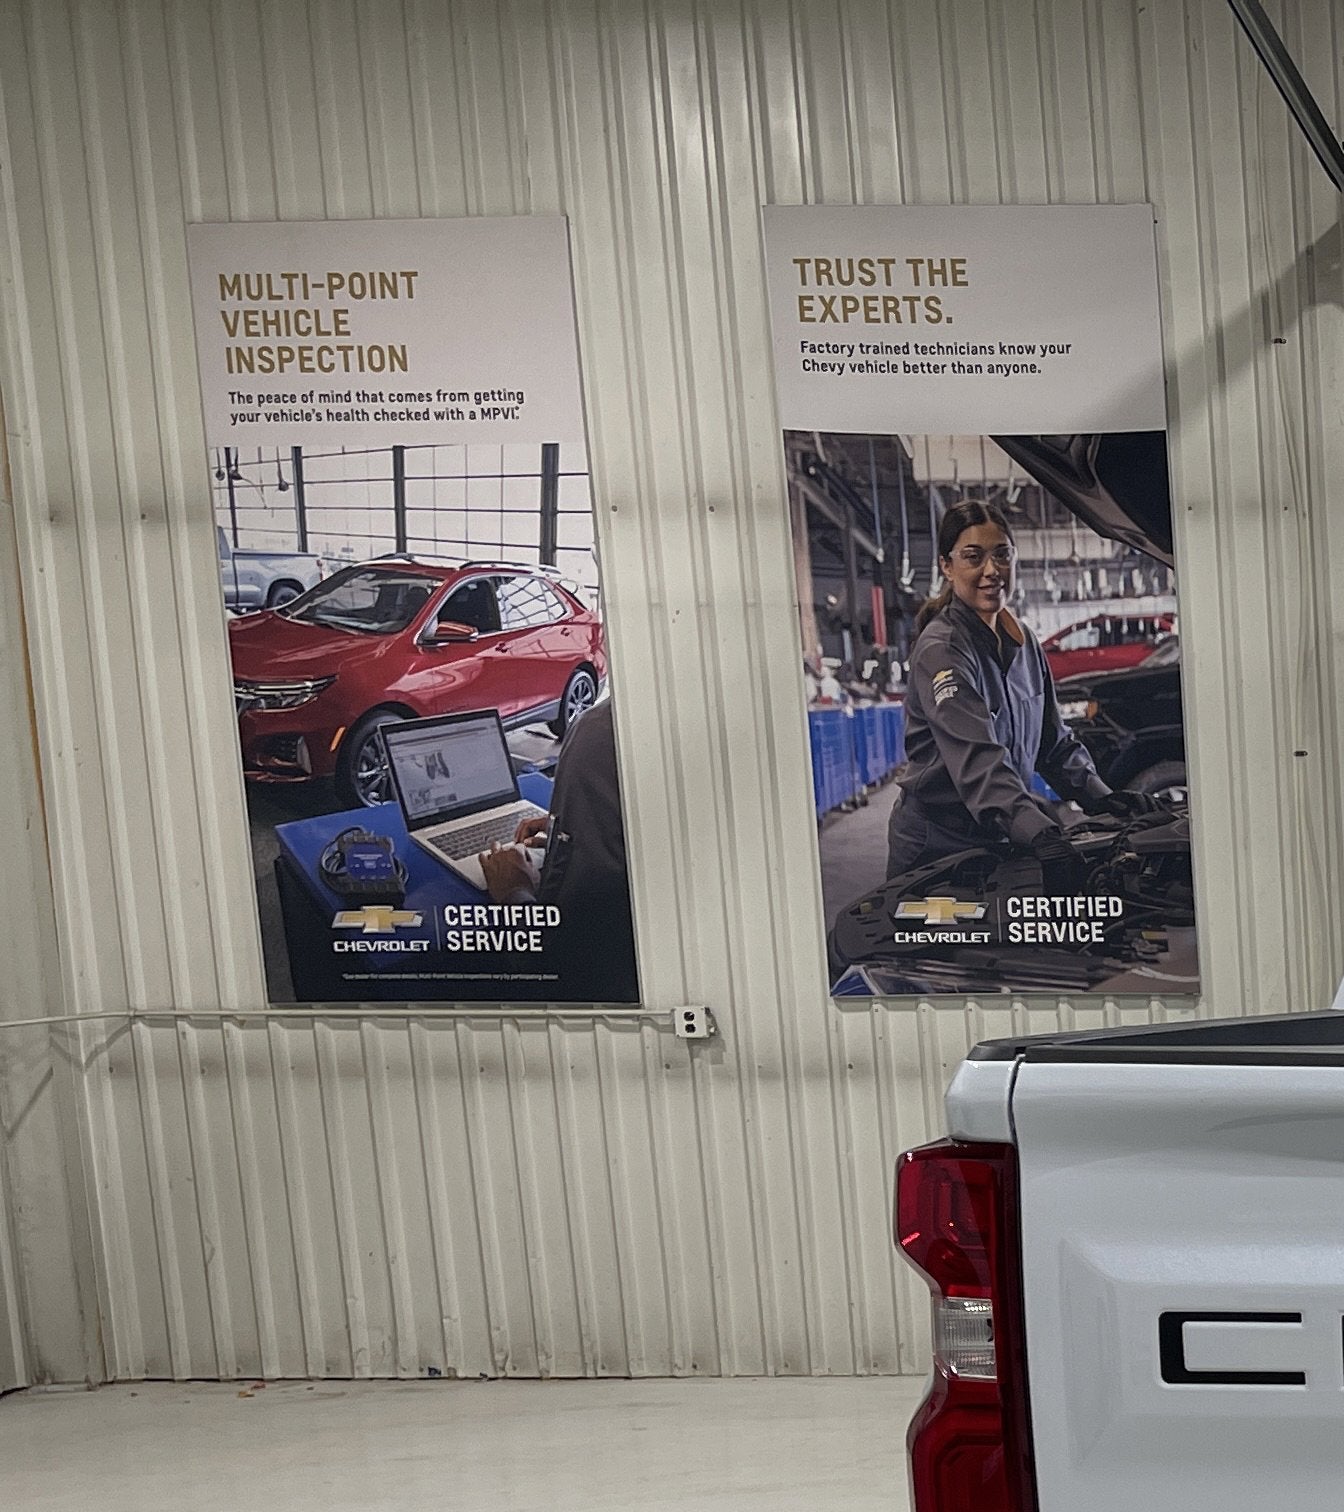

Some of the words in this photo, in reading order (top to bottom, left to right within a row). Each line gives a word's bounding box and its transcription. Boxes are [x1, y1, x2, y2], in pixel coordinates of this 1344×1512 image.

[792, 258, 896, 287] TRUST
[905, 258, 969, 287] THE
[218, 271, 419, 301] MULTI-POINT
[797, 296, 953, 324] EXPERTS.
[221, 309, 352, 338] VEHICLE
[225, 344, 409, 374] INSPECTION
[800, 341, 855, 357] Factory
[859, 341, 910, 356] trained
[914, 341, 995, 356] technicians
[999, 342, 1036, 355] know
[1040, 343, 1072, 357] your
[802, 359, 845, 375] Chevy
[849, 360, 898, 375] vehicle
[902, 360, 947, 376] better
[951, 361, 983, 375] than
[987, 363, 1042, 377] anyone.
[228, 391, 253, 404] The
[257, 393, 297, 407] peace
[301, 390, 314, 404] of
[319, 390, 351, 403] mind
[356, 390, 384, 403] that
[388, 392, 433, 403] comes
[436, 389, 470, 402] from
[474, 388, 525, 405] getting
[230, 413, 261, 426] your
[326, 408, 370, 422] health
[373, 408, 430, 421] checked
[433, 407, 464, 420] with
[468, 410, 477, 420] a
[444, 905, 561, 927] CERTIFIED
[1006, 896, 1124, 917] CERTIFIED
[446, 930, 544, 952] SERVICE
[894, 932, 991, 944] CHEVROLET
[1008, 921, 1106, 944] SERVICE
[333, 940, 431, 952] CHEVROLET
